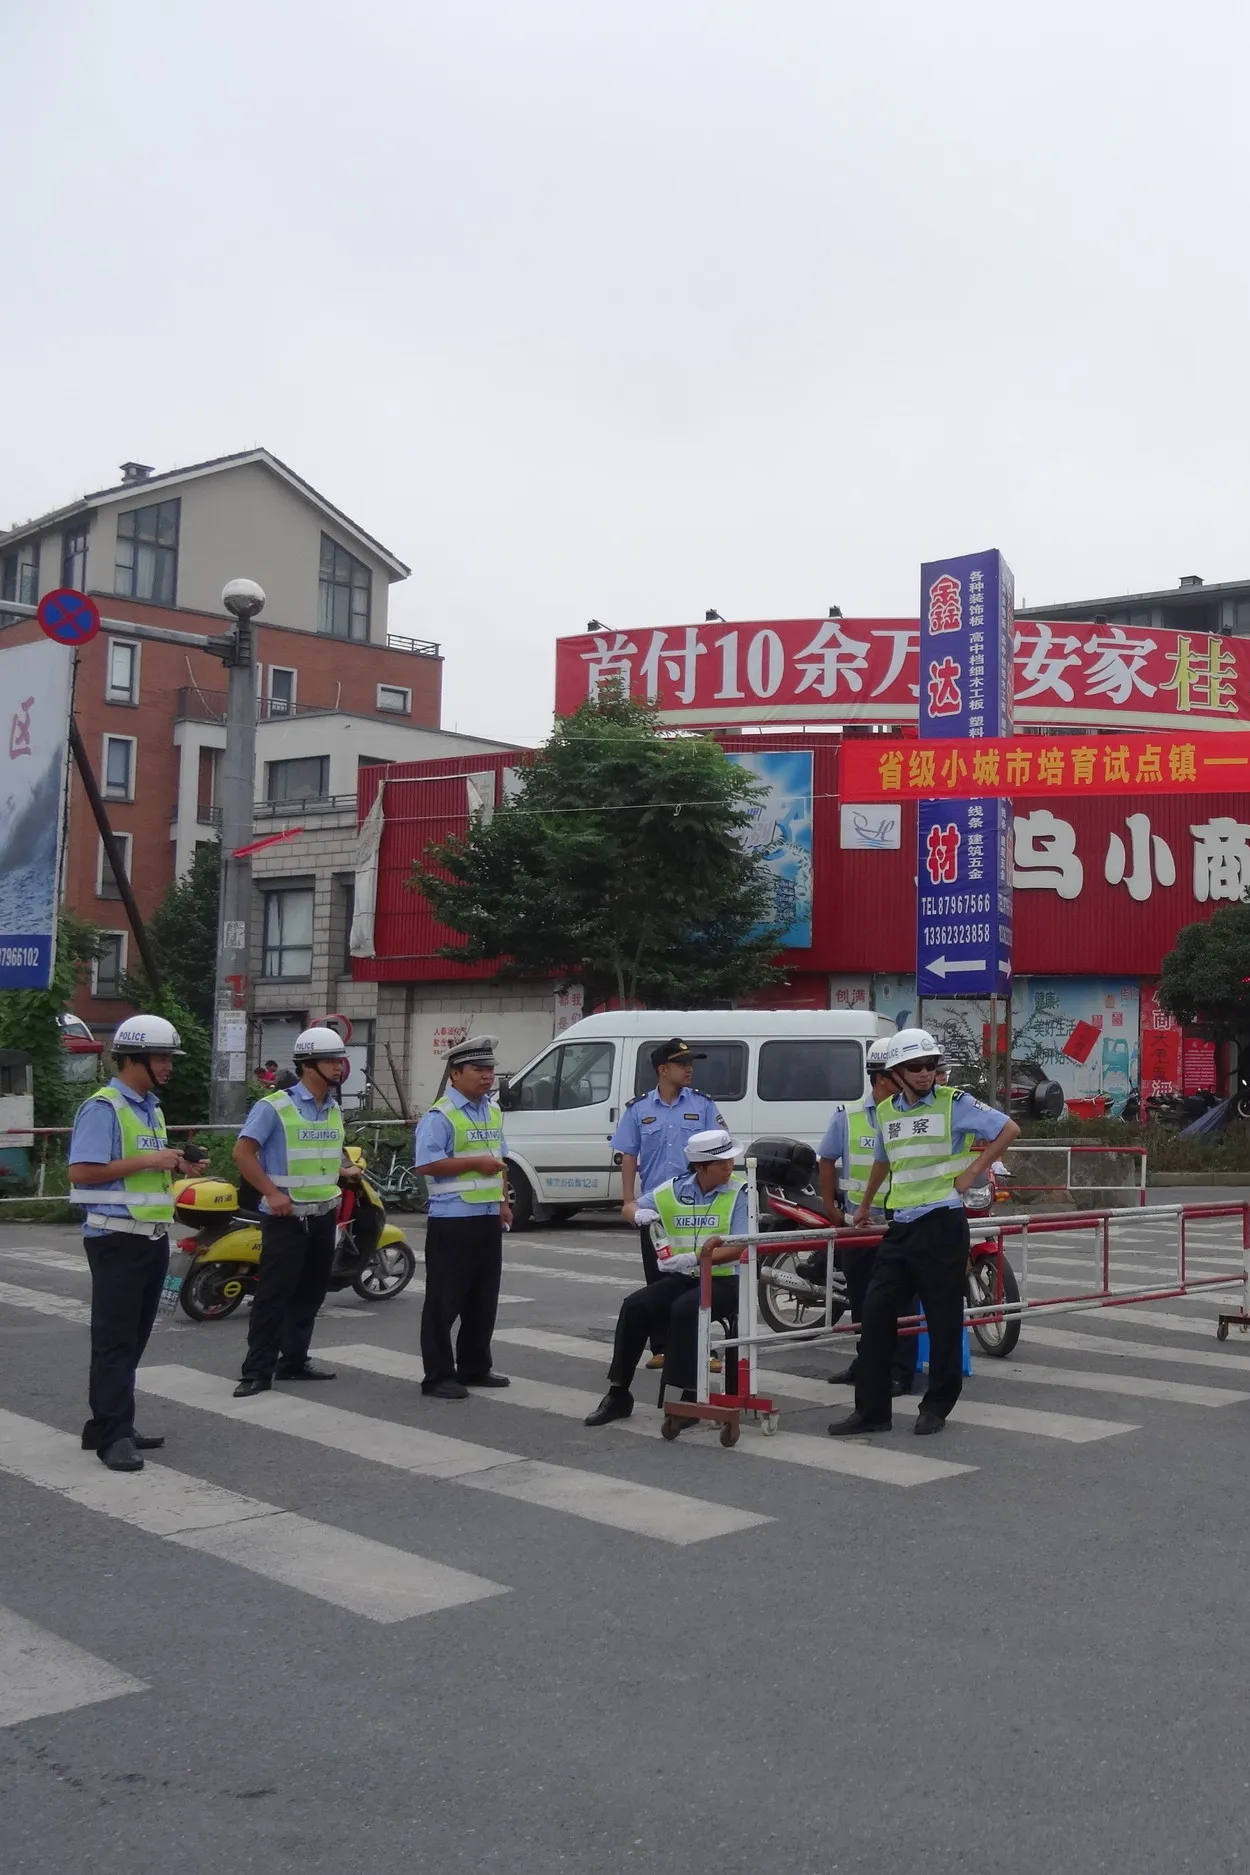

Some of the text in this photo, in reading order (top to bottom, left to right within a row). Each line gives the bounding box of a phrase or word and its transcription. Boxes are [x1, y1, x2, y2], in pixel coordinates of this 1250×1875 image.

[924, 923, 990, 946] 13362323858
[0, 947, 39, 967] 7966102
[119, 1031, 147, 1042] POLICE
[296, 1042, 315, 1051] POLICE
[302, 1129, 337, 1140] XIEJING
[888, 1118, 930, 1140] 警察
[675, 1216, 716, 1227] XIEJING
